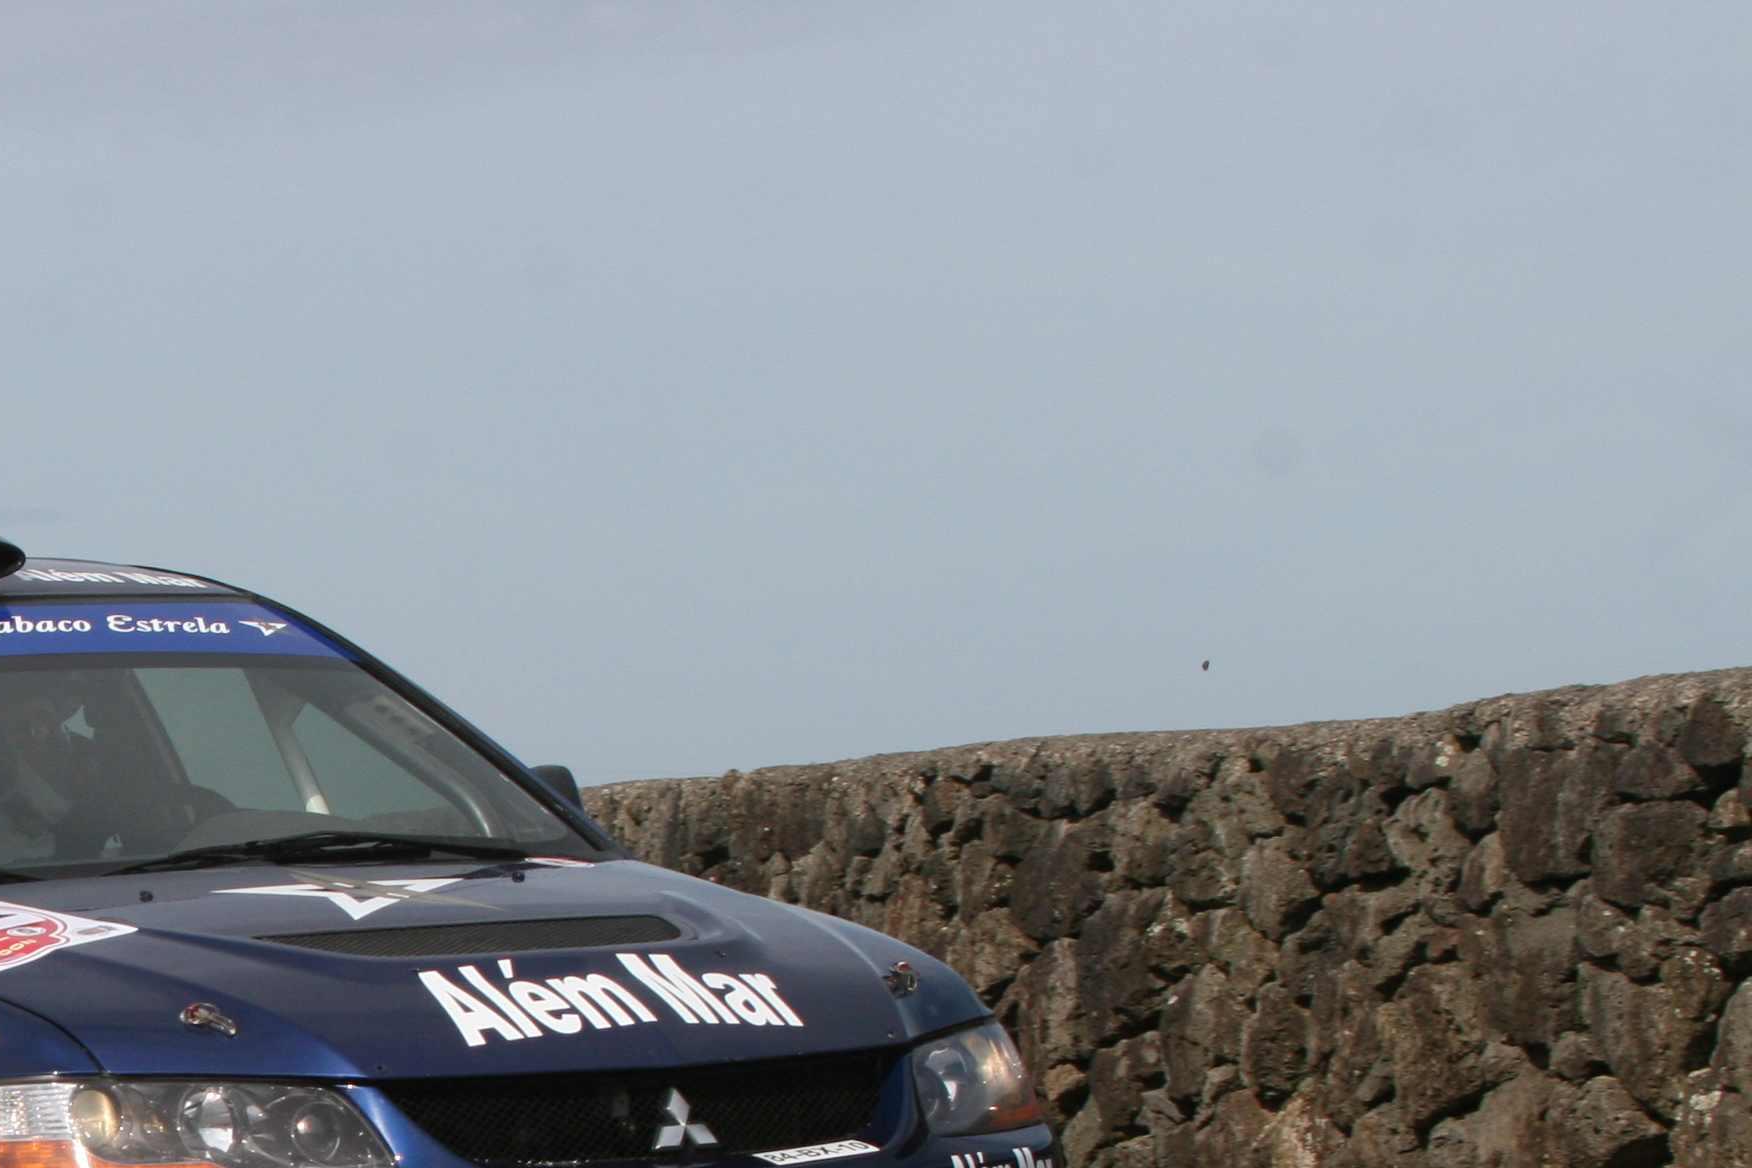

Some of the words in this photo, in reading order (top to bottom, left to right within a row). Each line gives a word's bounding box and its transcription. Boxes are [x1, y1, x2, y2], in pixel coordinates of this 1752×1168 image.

[106, 614, 230, 634] Estrela
[417, 959, 657, 1048] Além
[616, 952, 804, 1027] Mar
